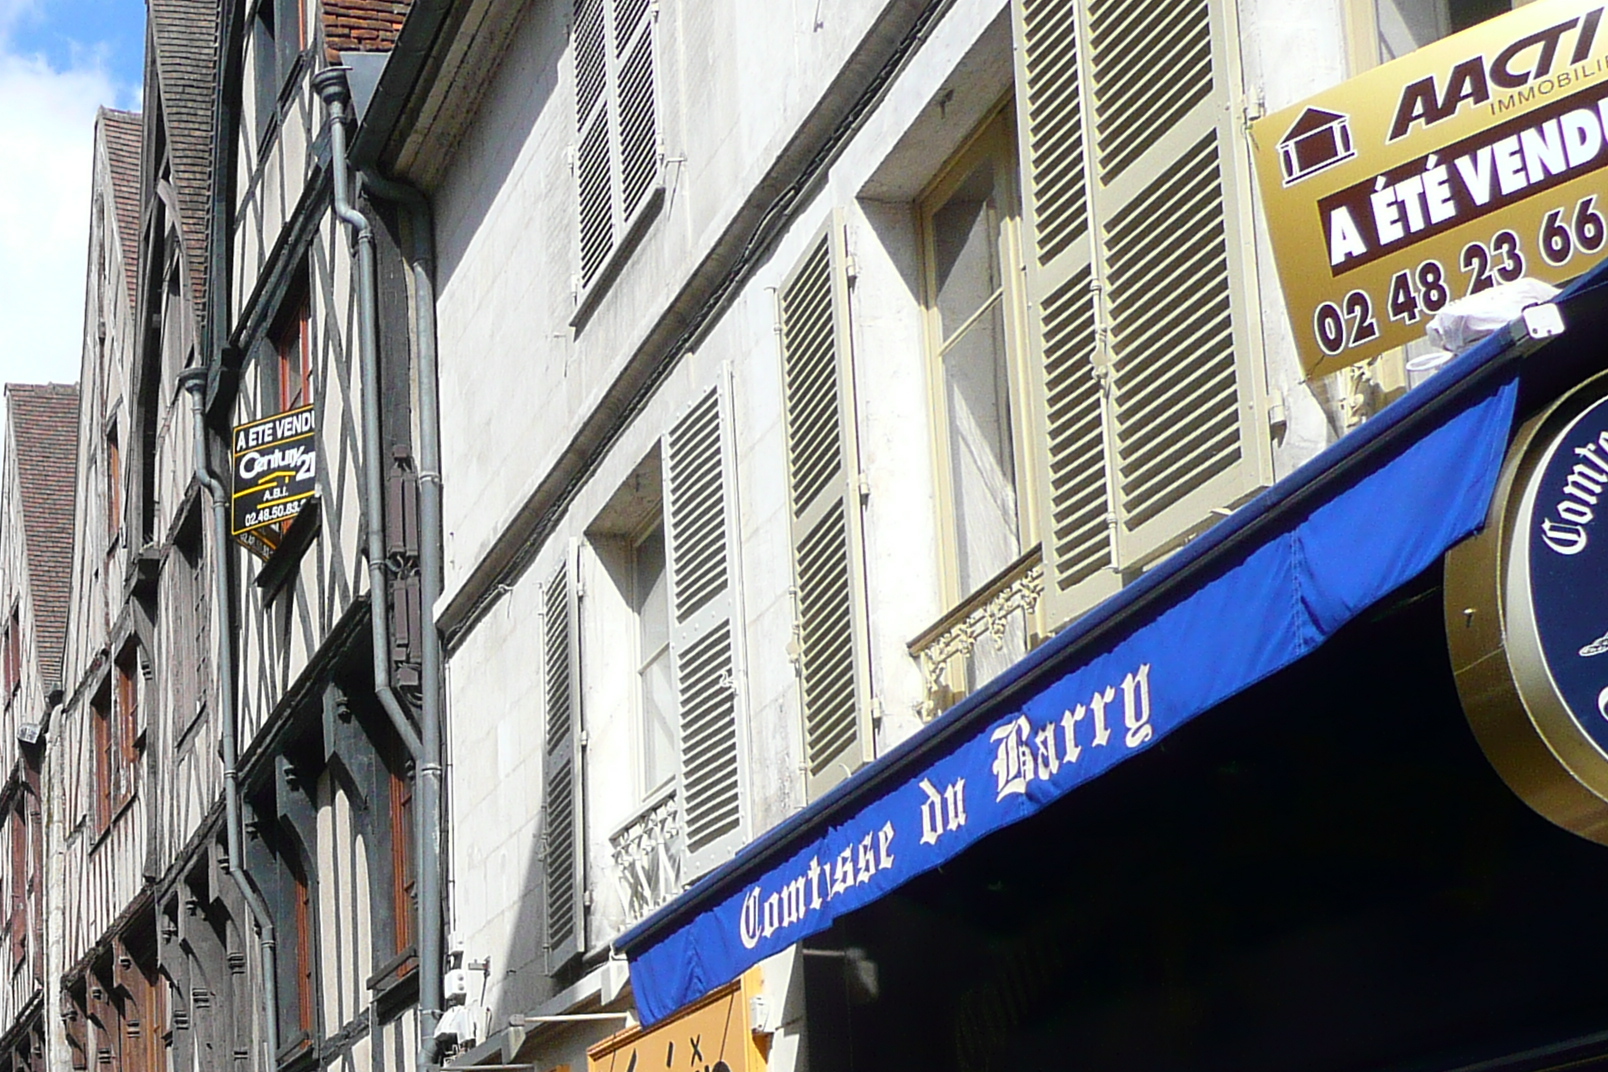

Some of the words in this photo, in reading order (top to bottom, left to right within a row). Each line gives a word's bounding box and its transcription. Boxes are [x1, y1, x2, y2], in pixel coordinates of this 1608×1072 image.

[1490, 55, 1608, 116] IMMOBILI
[1330, 205, 1368, 267] A
[1370, 154, 1457, 246] ÉTÉ
[1315, 290, 1380, 356] 02
[1389, 260, 1449, 325] 48
[1461, 229, 1526, 297] 23
[1540, 194, 1606, 265] 66
[236, 430, 247, 452] A
[248, 421, 274, 448] ETE
[239, 445, 306, 480] Century
[296, 450, 316, 482] 21
[263, 486, 289, 502] A.B.I.
[920, 776, 967, 845] du
[991, 663, 1155, 802] Barry
